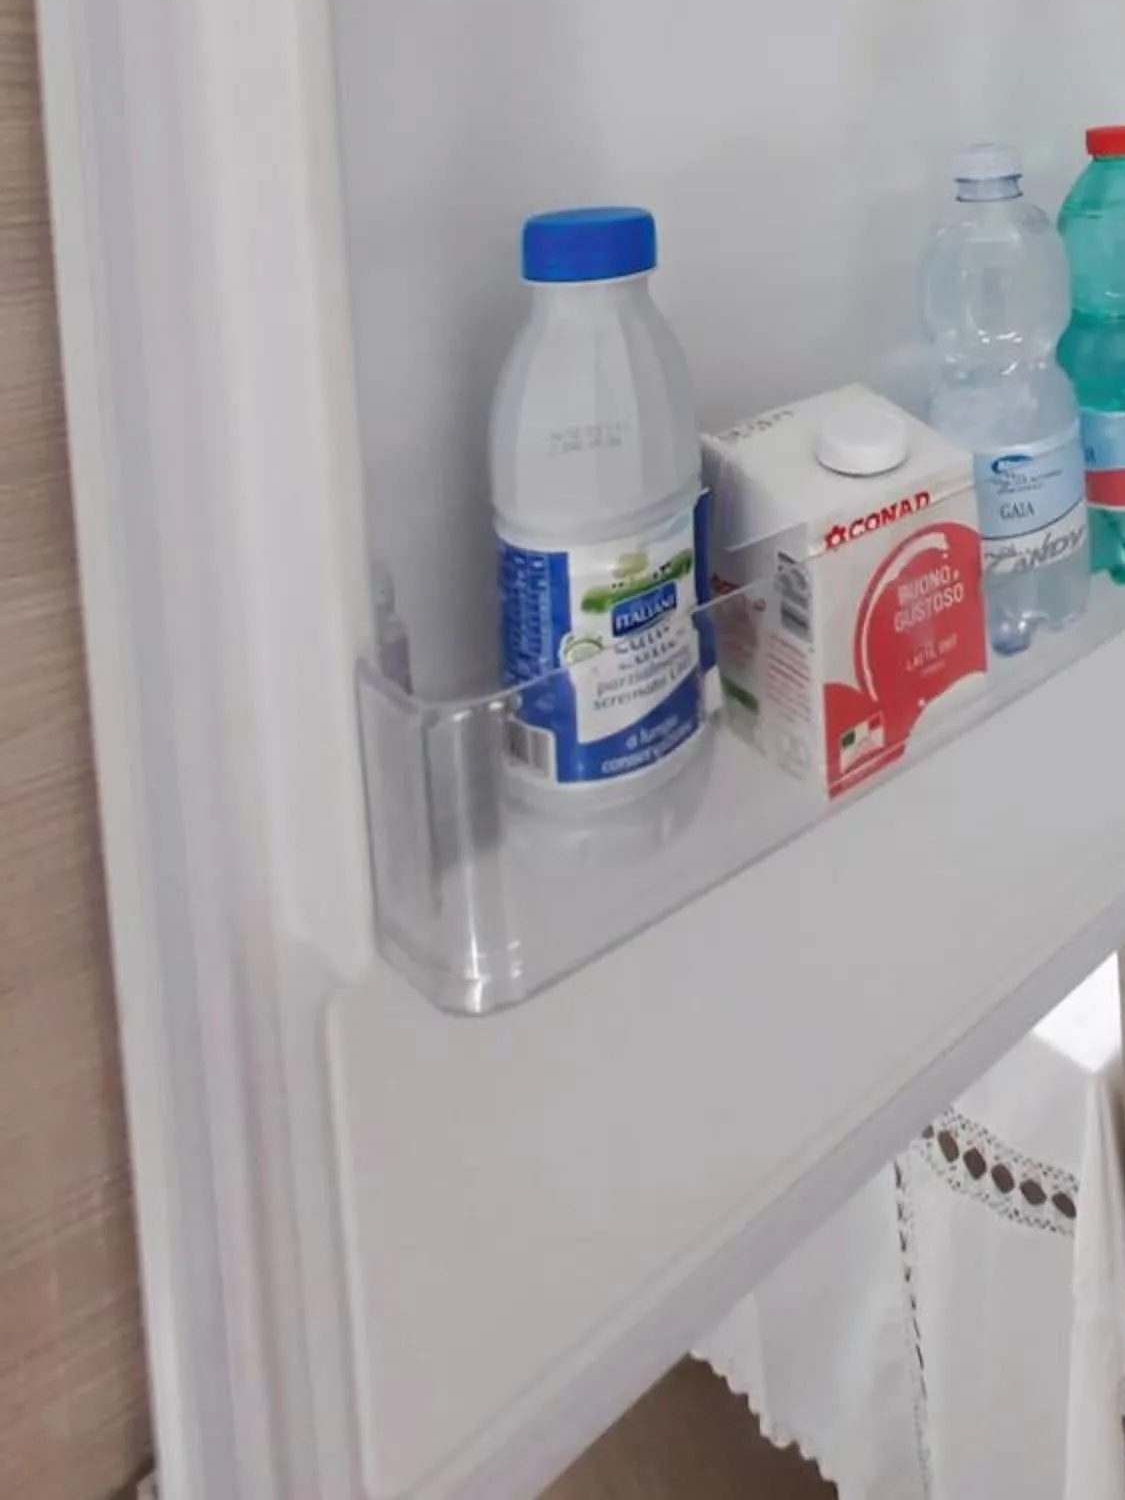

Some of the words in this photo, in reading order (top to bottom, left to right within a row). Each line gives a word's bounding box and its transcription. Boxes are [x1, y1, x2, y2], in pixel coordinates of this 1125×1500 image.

[848, 491, 930, 540] CONAD
[1000, 502, 1035, 520] GAIA
[893, 583, 964, 633] GUSTOSO
